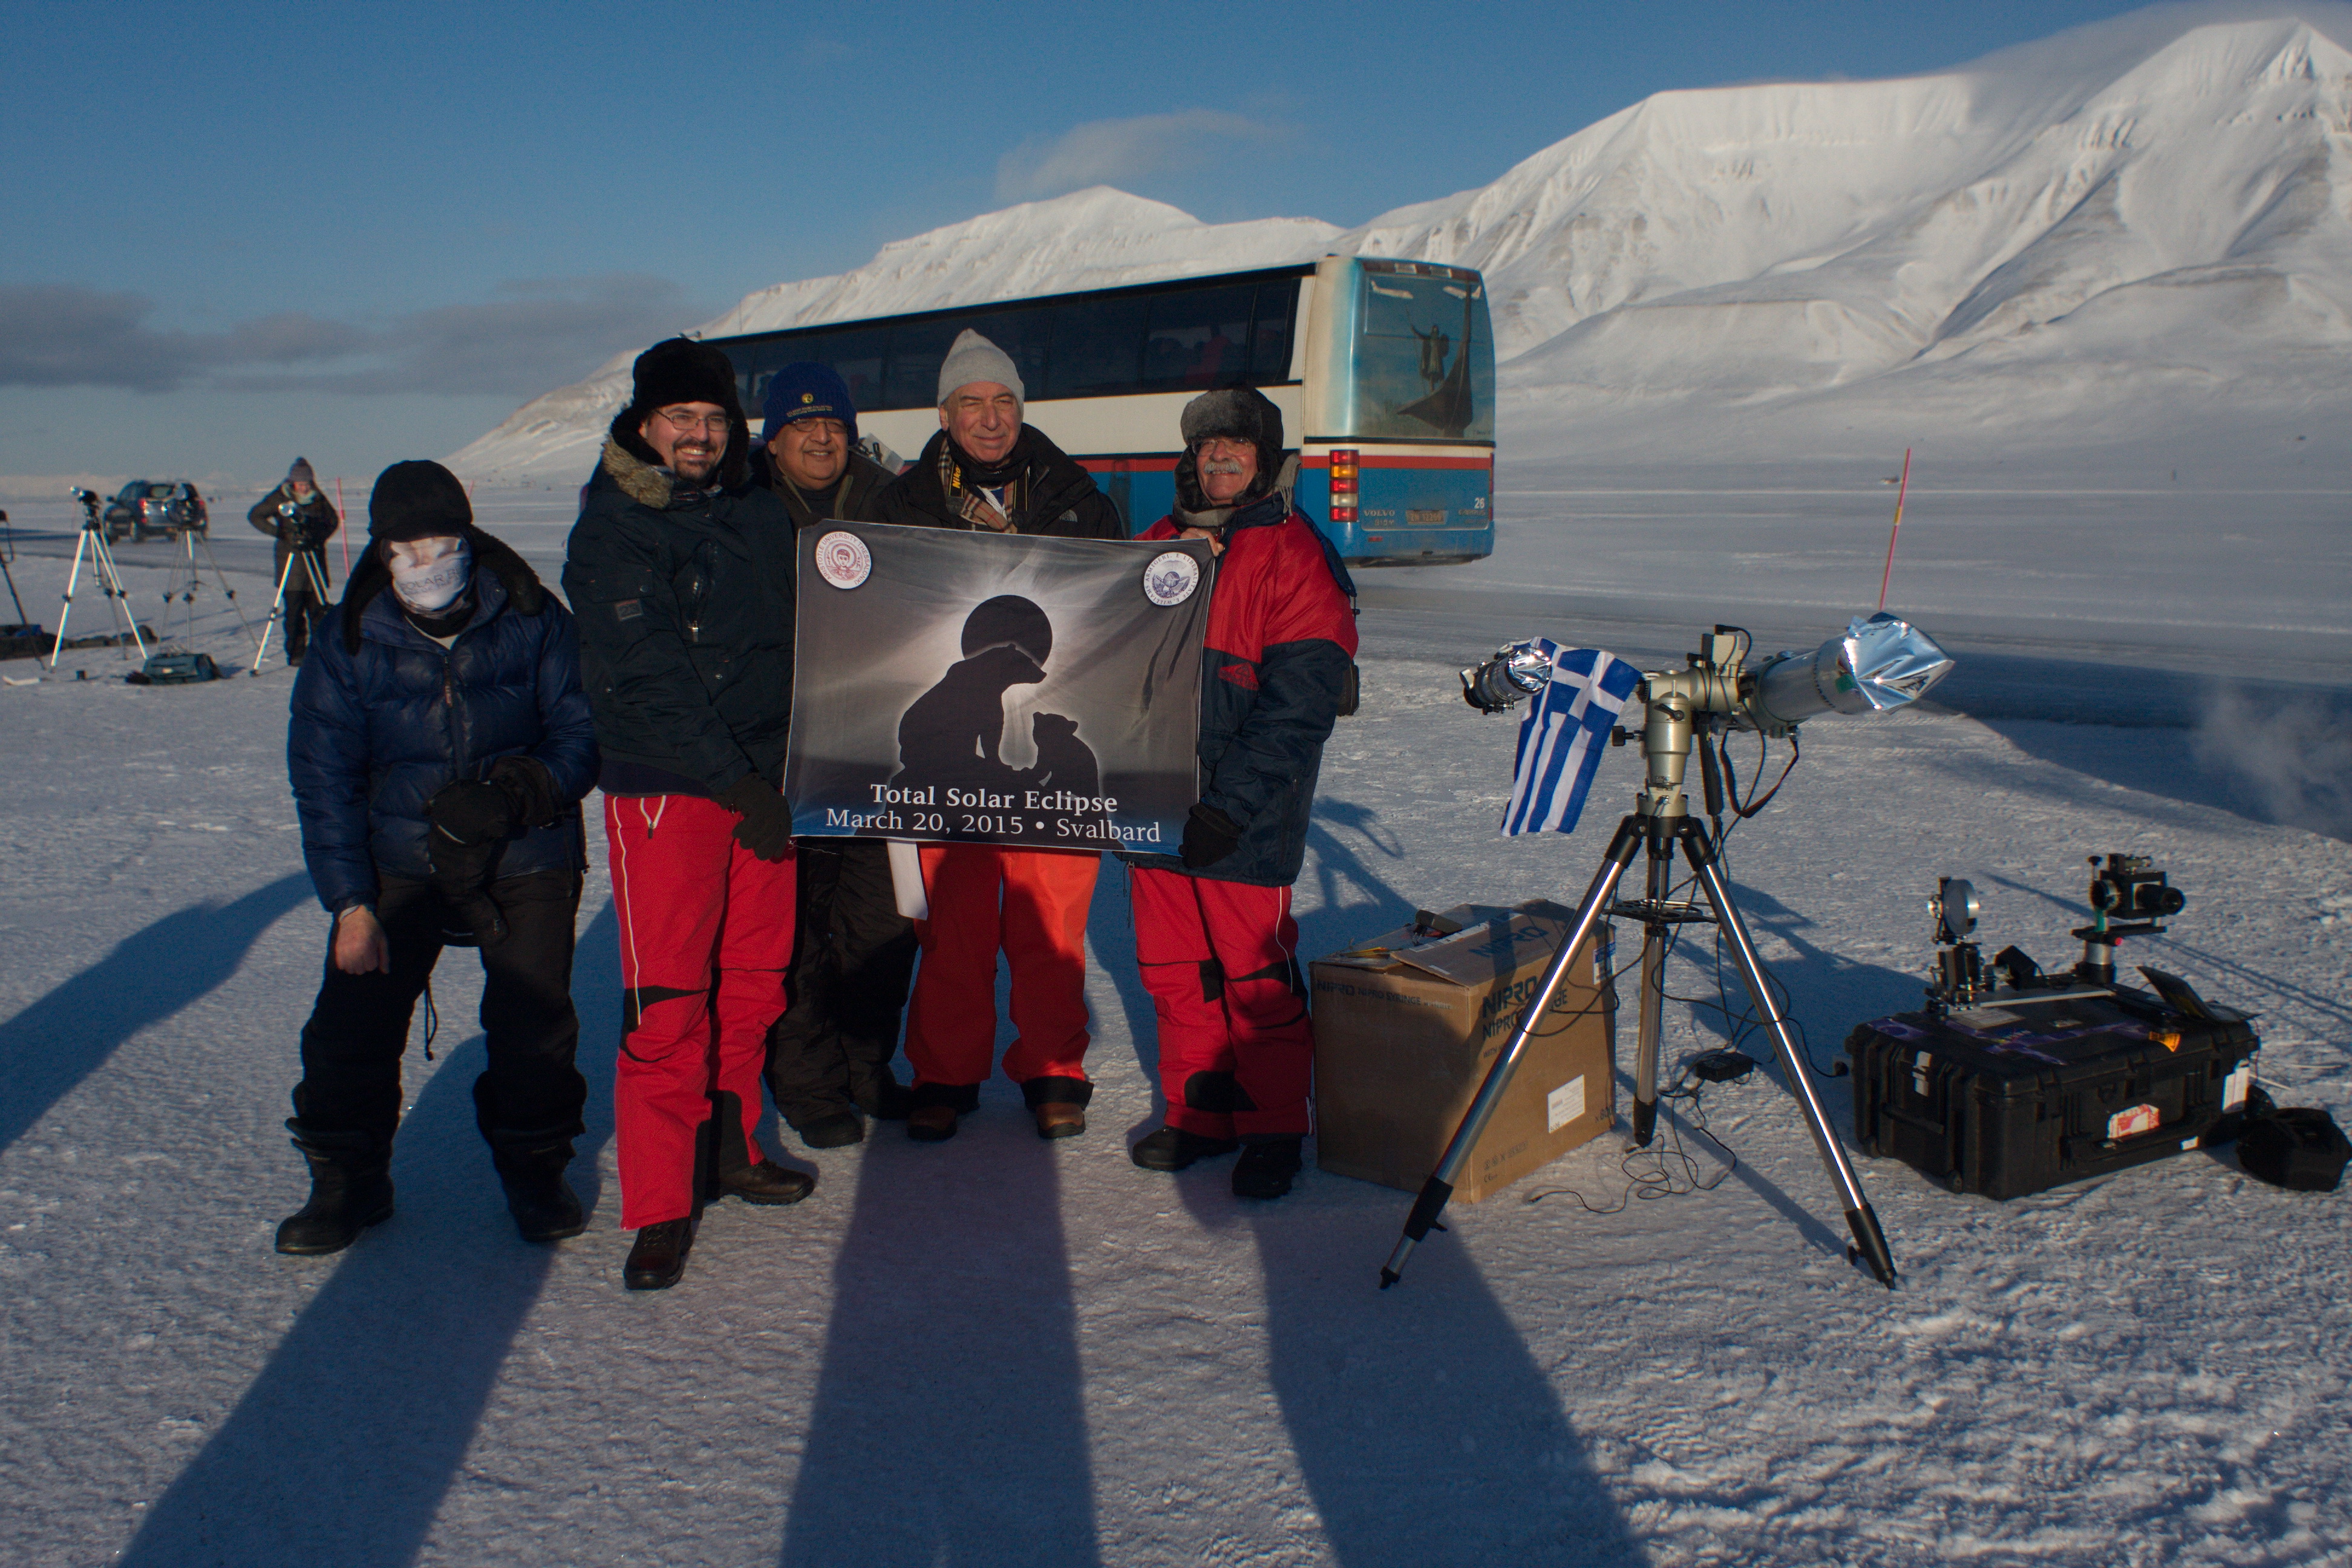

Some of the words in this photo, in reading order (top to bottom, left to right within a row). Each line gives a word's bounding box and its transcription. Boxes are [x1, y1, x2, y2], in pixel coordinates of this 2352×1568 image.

[822, 532, 858, 545] UNIVERSITY
[817, 545, 832, 580] ARISTOTLE
[1145, 585, 1172, 605] WILLIAMS
[871, 783, 936, 805] Total
[946, 788, 1015, 808] Solar
[1024, 790, 1118, 816] Eclipse
[826, 808, 903, 829] March
[912, 812, 951, 834] 20,
[962, 815, 1024, 834] 2015
[1056, 818, 1161, 843] Svalbard
[1316, 979, 1355, 996] NIPRO
[1358, 987, 1384, 999] NIPRO
[1386, 992, 1421, 1005] SYRINGE
[1482, 975, 1538, 1018] NIPRO
